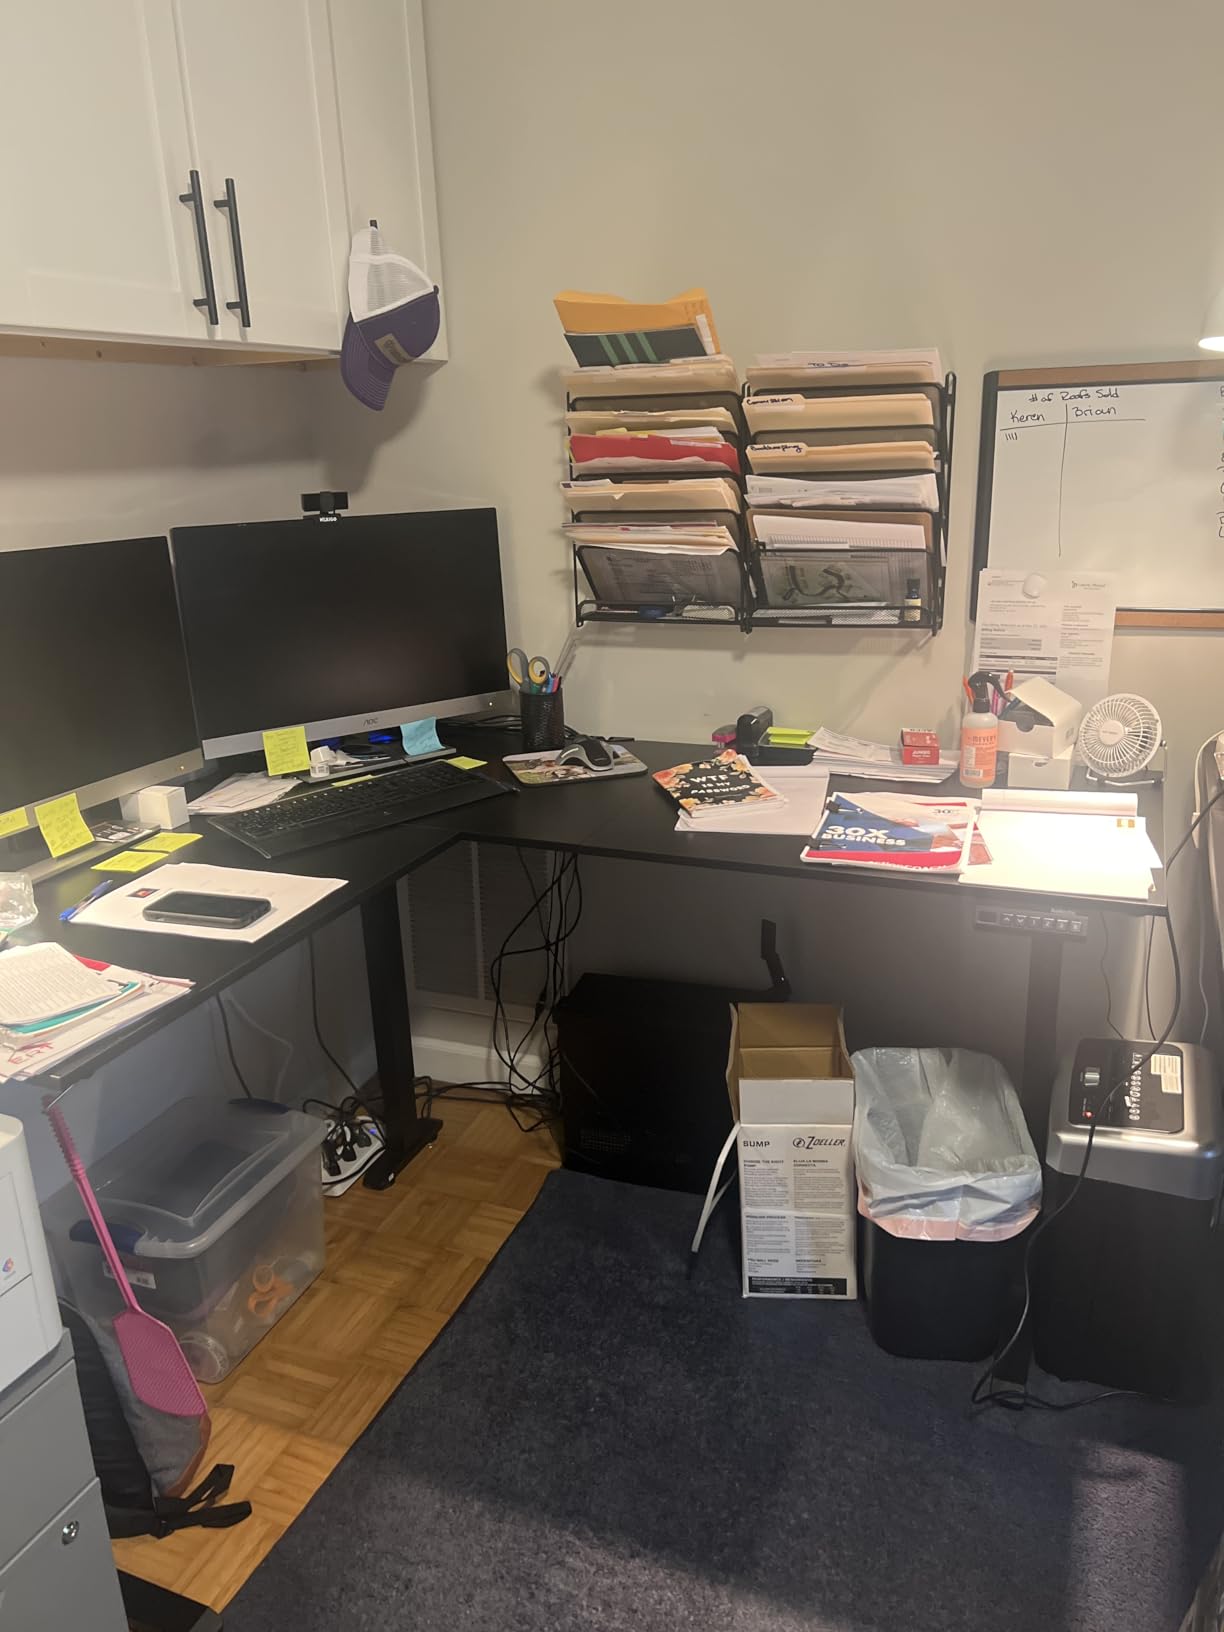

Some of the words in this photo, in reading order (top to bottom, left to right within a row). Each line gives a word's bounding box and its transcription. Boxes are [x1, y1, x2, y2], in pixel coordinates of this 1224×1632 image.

[1096, 388, 1119, 398] Sold
[1072, 405, 1117, 417] Brian
[363, 718, 379, 727] AOC
[690, 774, 729, 783] WTF
[690, 784, 750, 794] PASSWORD
[824, 825, 890, 839] 30X
[821, 833, 906, 847] BUSINESS
[743, 1140, 770, 1148] SUMP
[806, 1136, 846, 1149] ZOELLER
